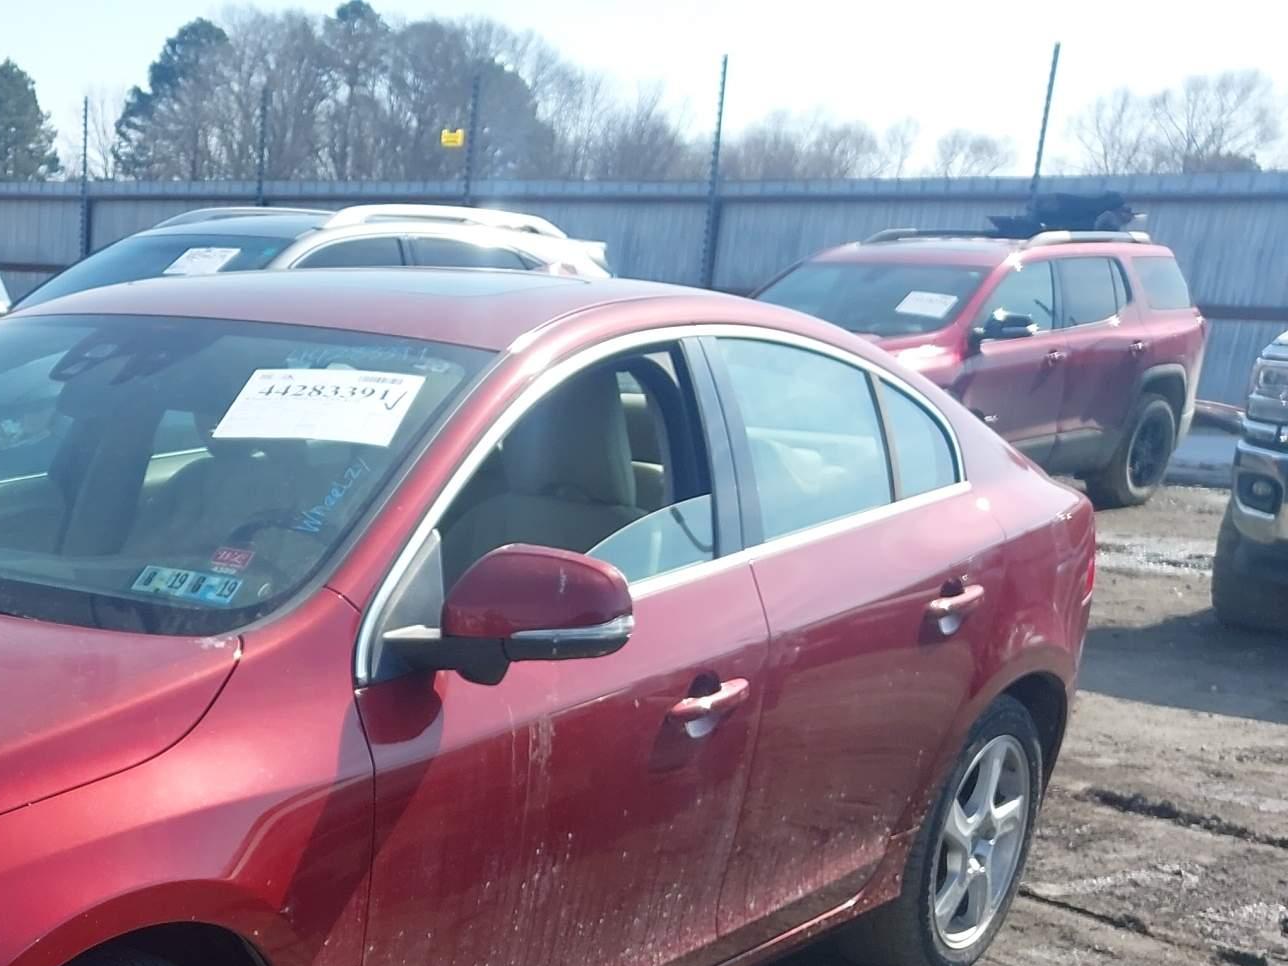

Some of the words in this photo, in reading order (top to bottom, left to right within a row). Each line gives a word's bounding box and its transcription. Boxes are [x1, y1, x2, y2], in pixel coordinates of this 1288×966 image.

[258, 384, 389, 400] 44283391
[167, 572, 190, 590] 19
[215, 579, 238, 599] 19
